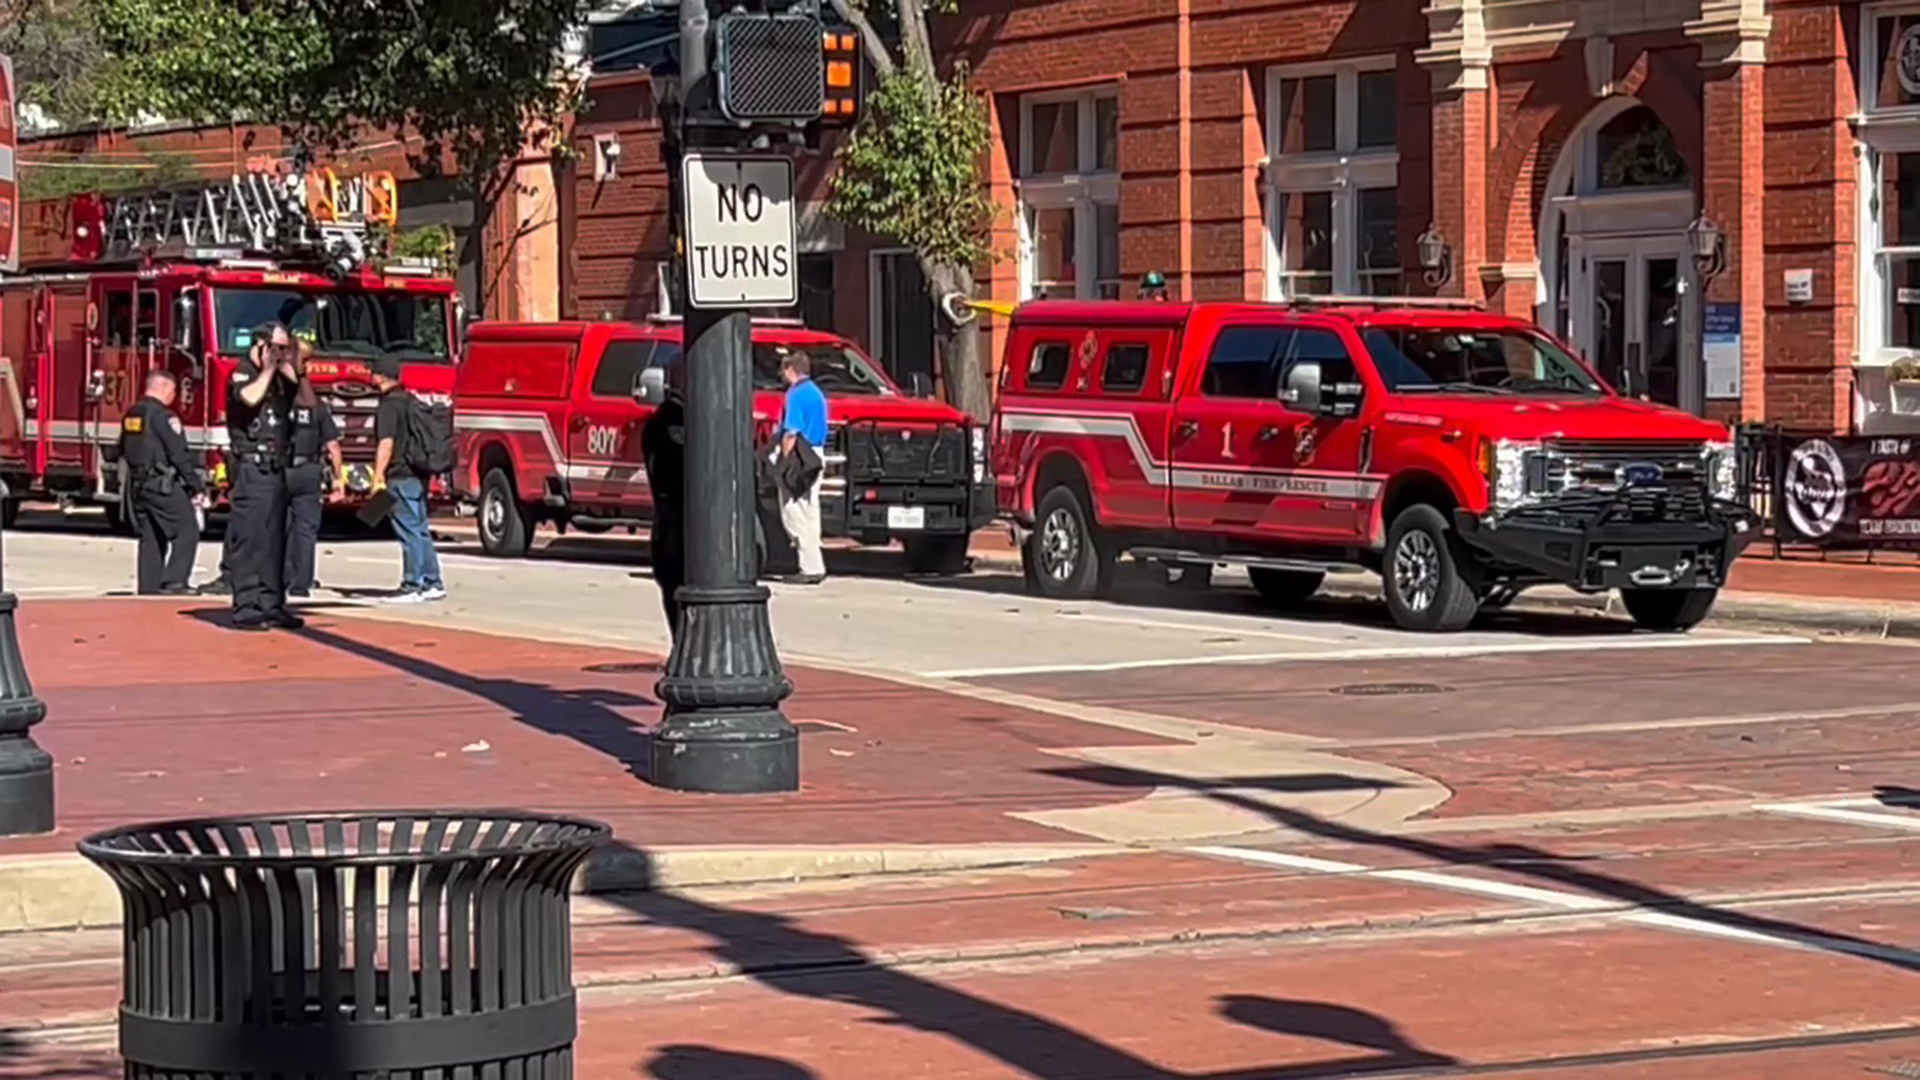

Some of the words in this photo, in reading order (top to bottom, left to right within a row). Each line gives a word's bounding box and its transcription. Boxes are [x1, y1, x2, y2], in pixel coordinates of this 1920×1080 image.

[718, 183, 762, 222] NO
[694, 245, 788, 278] TURNS
[588, 424, 617, 455] 807
[1221, 421, 1234, 458] 1
[1201, 473, 1244, 488] DALLAS
